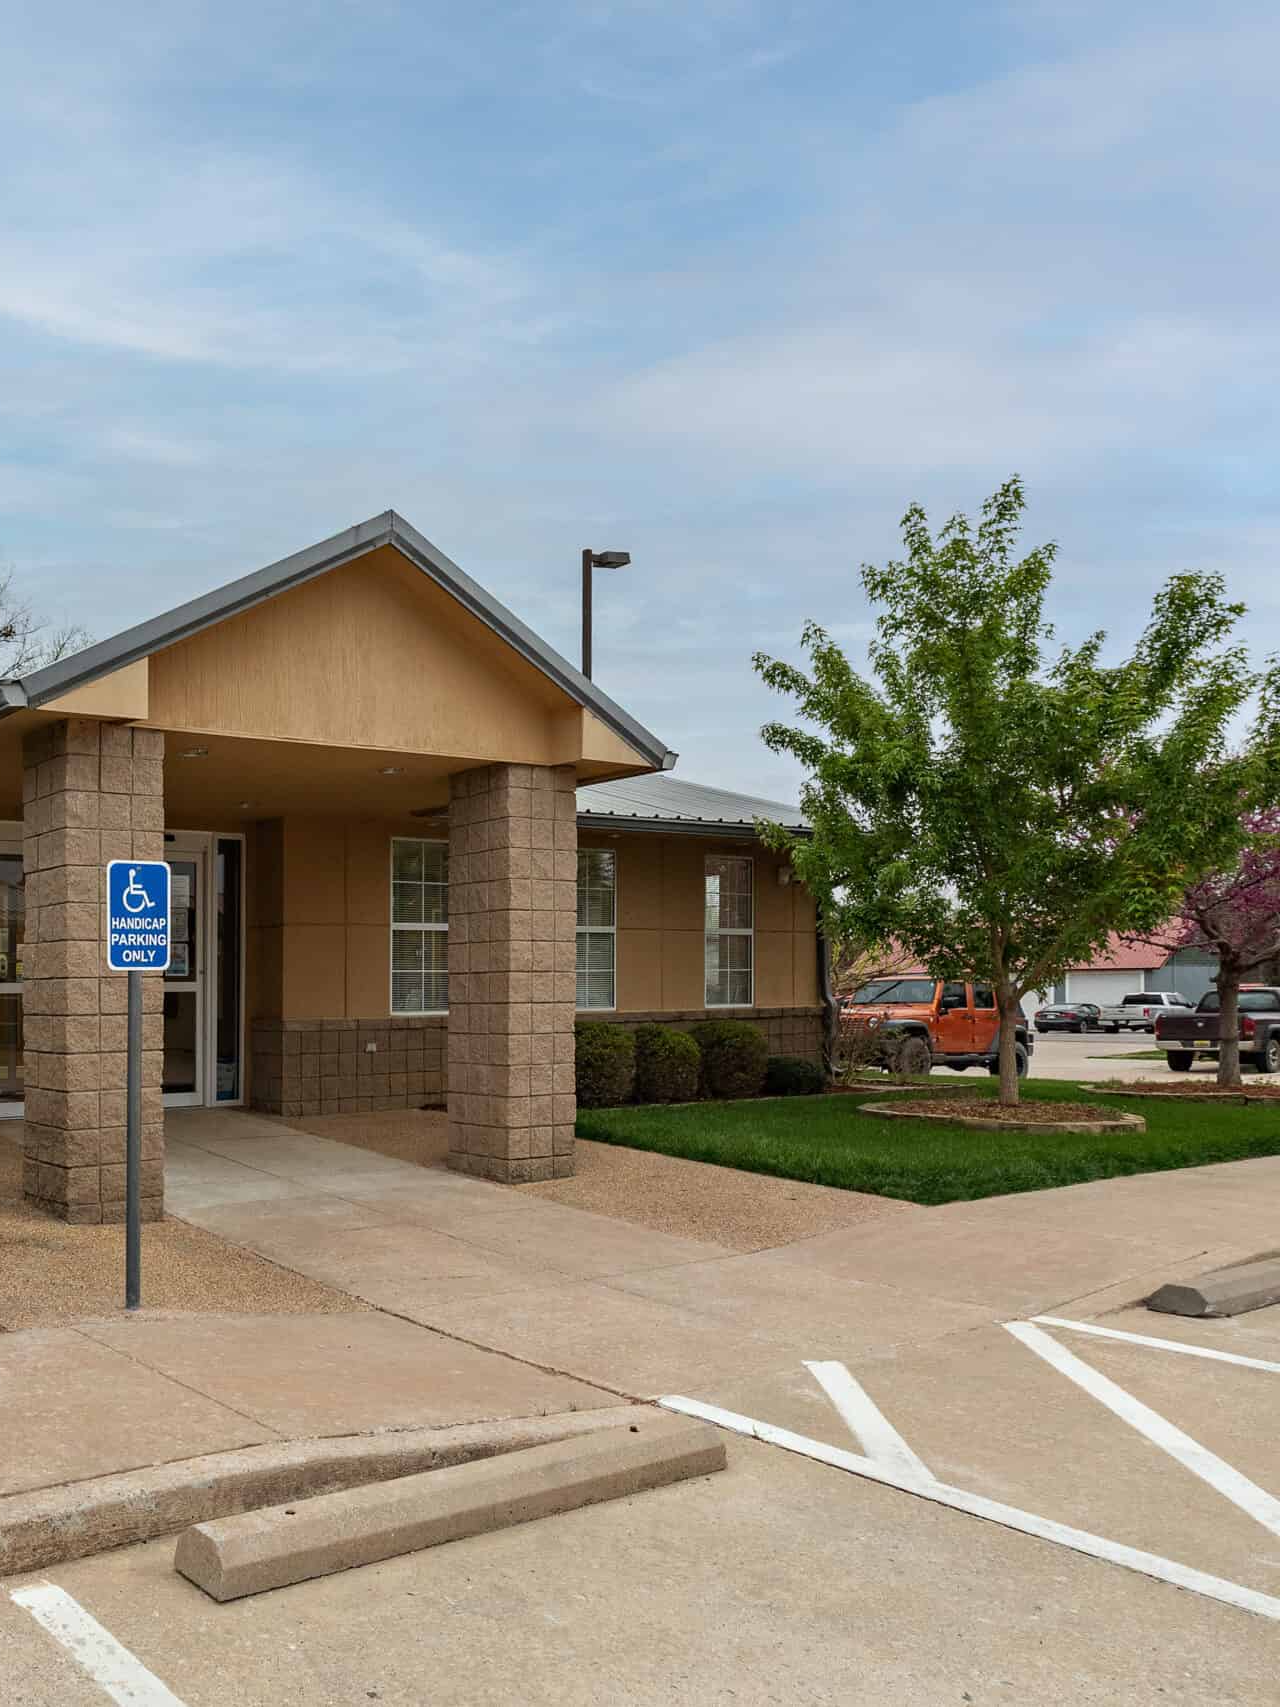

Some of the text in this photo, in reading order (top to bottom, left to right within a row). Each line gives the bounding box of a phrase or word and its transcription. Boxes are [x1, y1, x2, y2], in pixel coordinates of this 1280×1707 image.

[112, 917, 166, 930] HANDICAP
[112, 934, 167, 946] PARKING
[122, 950, 156, 962] ONLY
